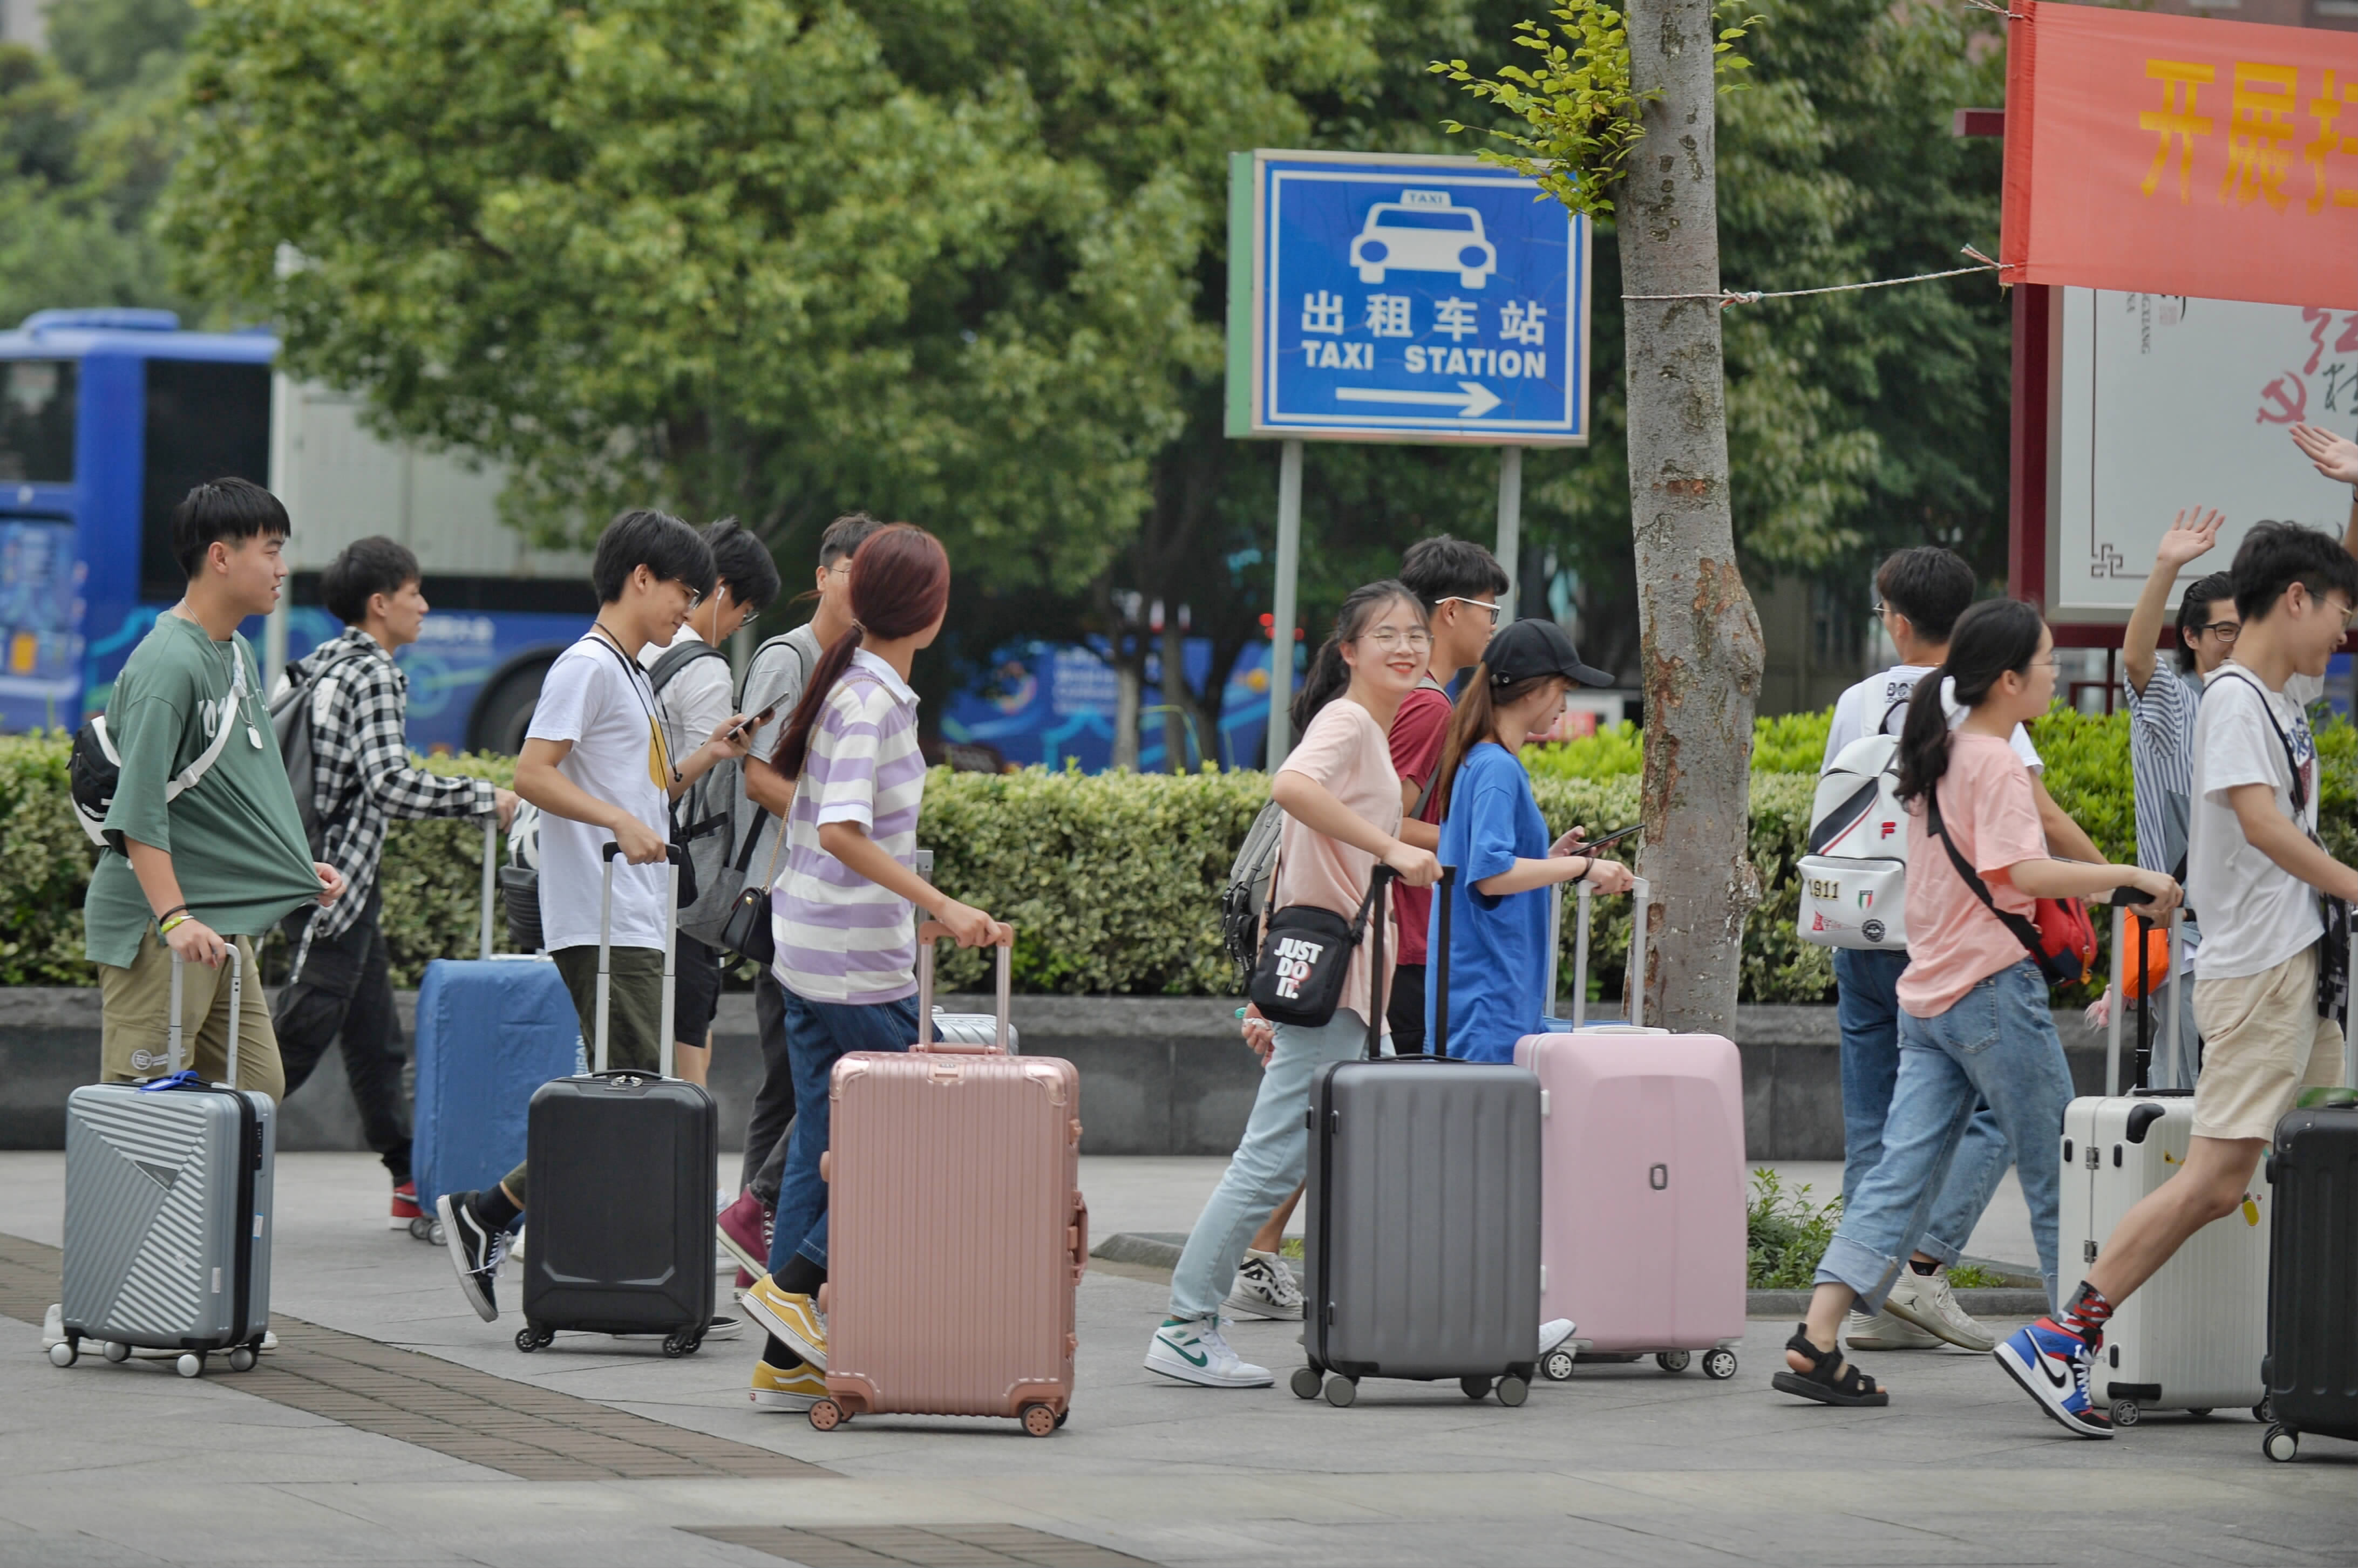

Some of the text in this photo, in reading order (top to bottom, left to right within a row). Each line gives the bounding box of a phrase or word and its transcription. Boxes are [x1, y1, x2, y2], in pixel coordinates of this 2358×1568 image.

[1409, 193, 1443, 204] TAXI
[1301, 290, 1548, 346] 出租车站
[1301, 339, 1547, 379] TAXI STATION
[1274, 937, 1324, 964] JUST
[1275, 957, 1309, 981] DO
